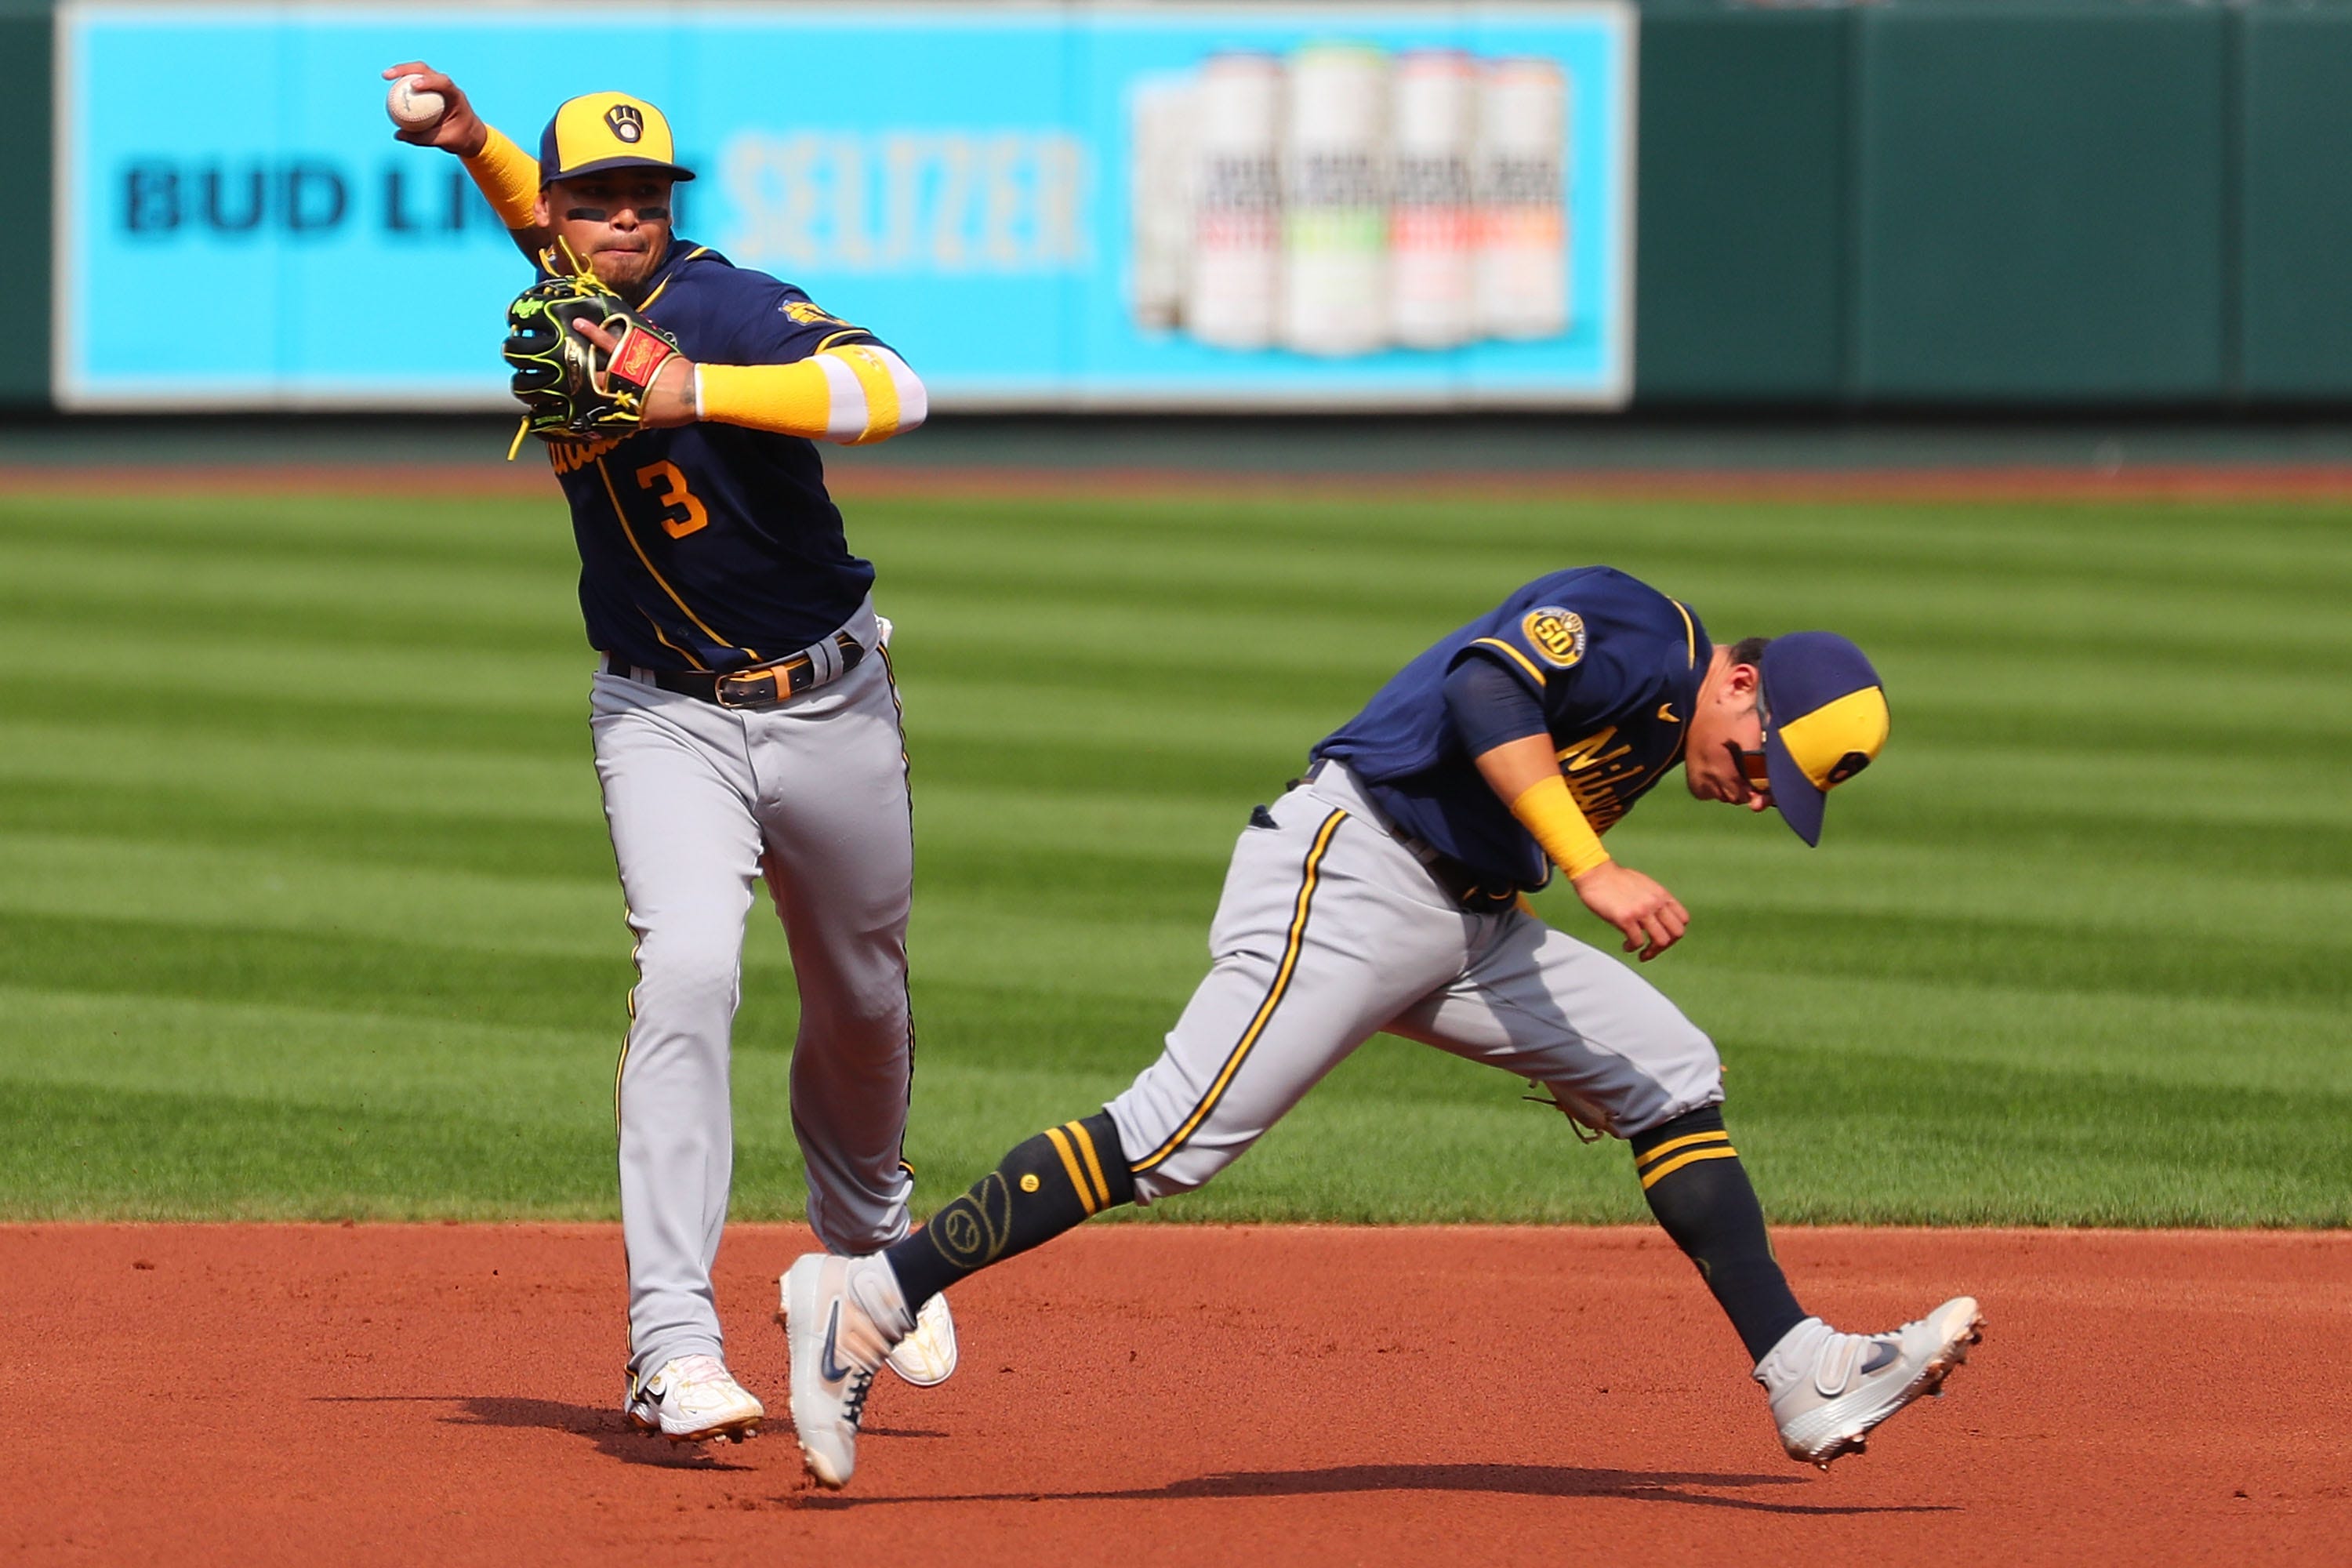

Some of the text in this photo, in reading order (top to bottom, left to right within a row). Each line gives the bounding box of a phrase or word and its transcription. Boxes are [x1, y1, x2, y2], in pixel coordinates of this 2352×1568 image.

[124, 162, 350, 235] BUD
[724, 134, 1088, 267] SELTZER
[635, 459, 710, 539] 3
[1534, 616, 1574, 655] 50
